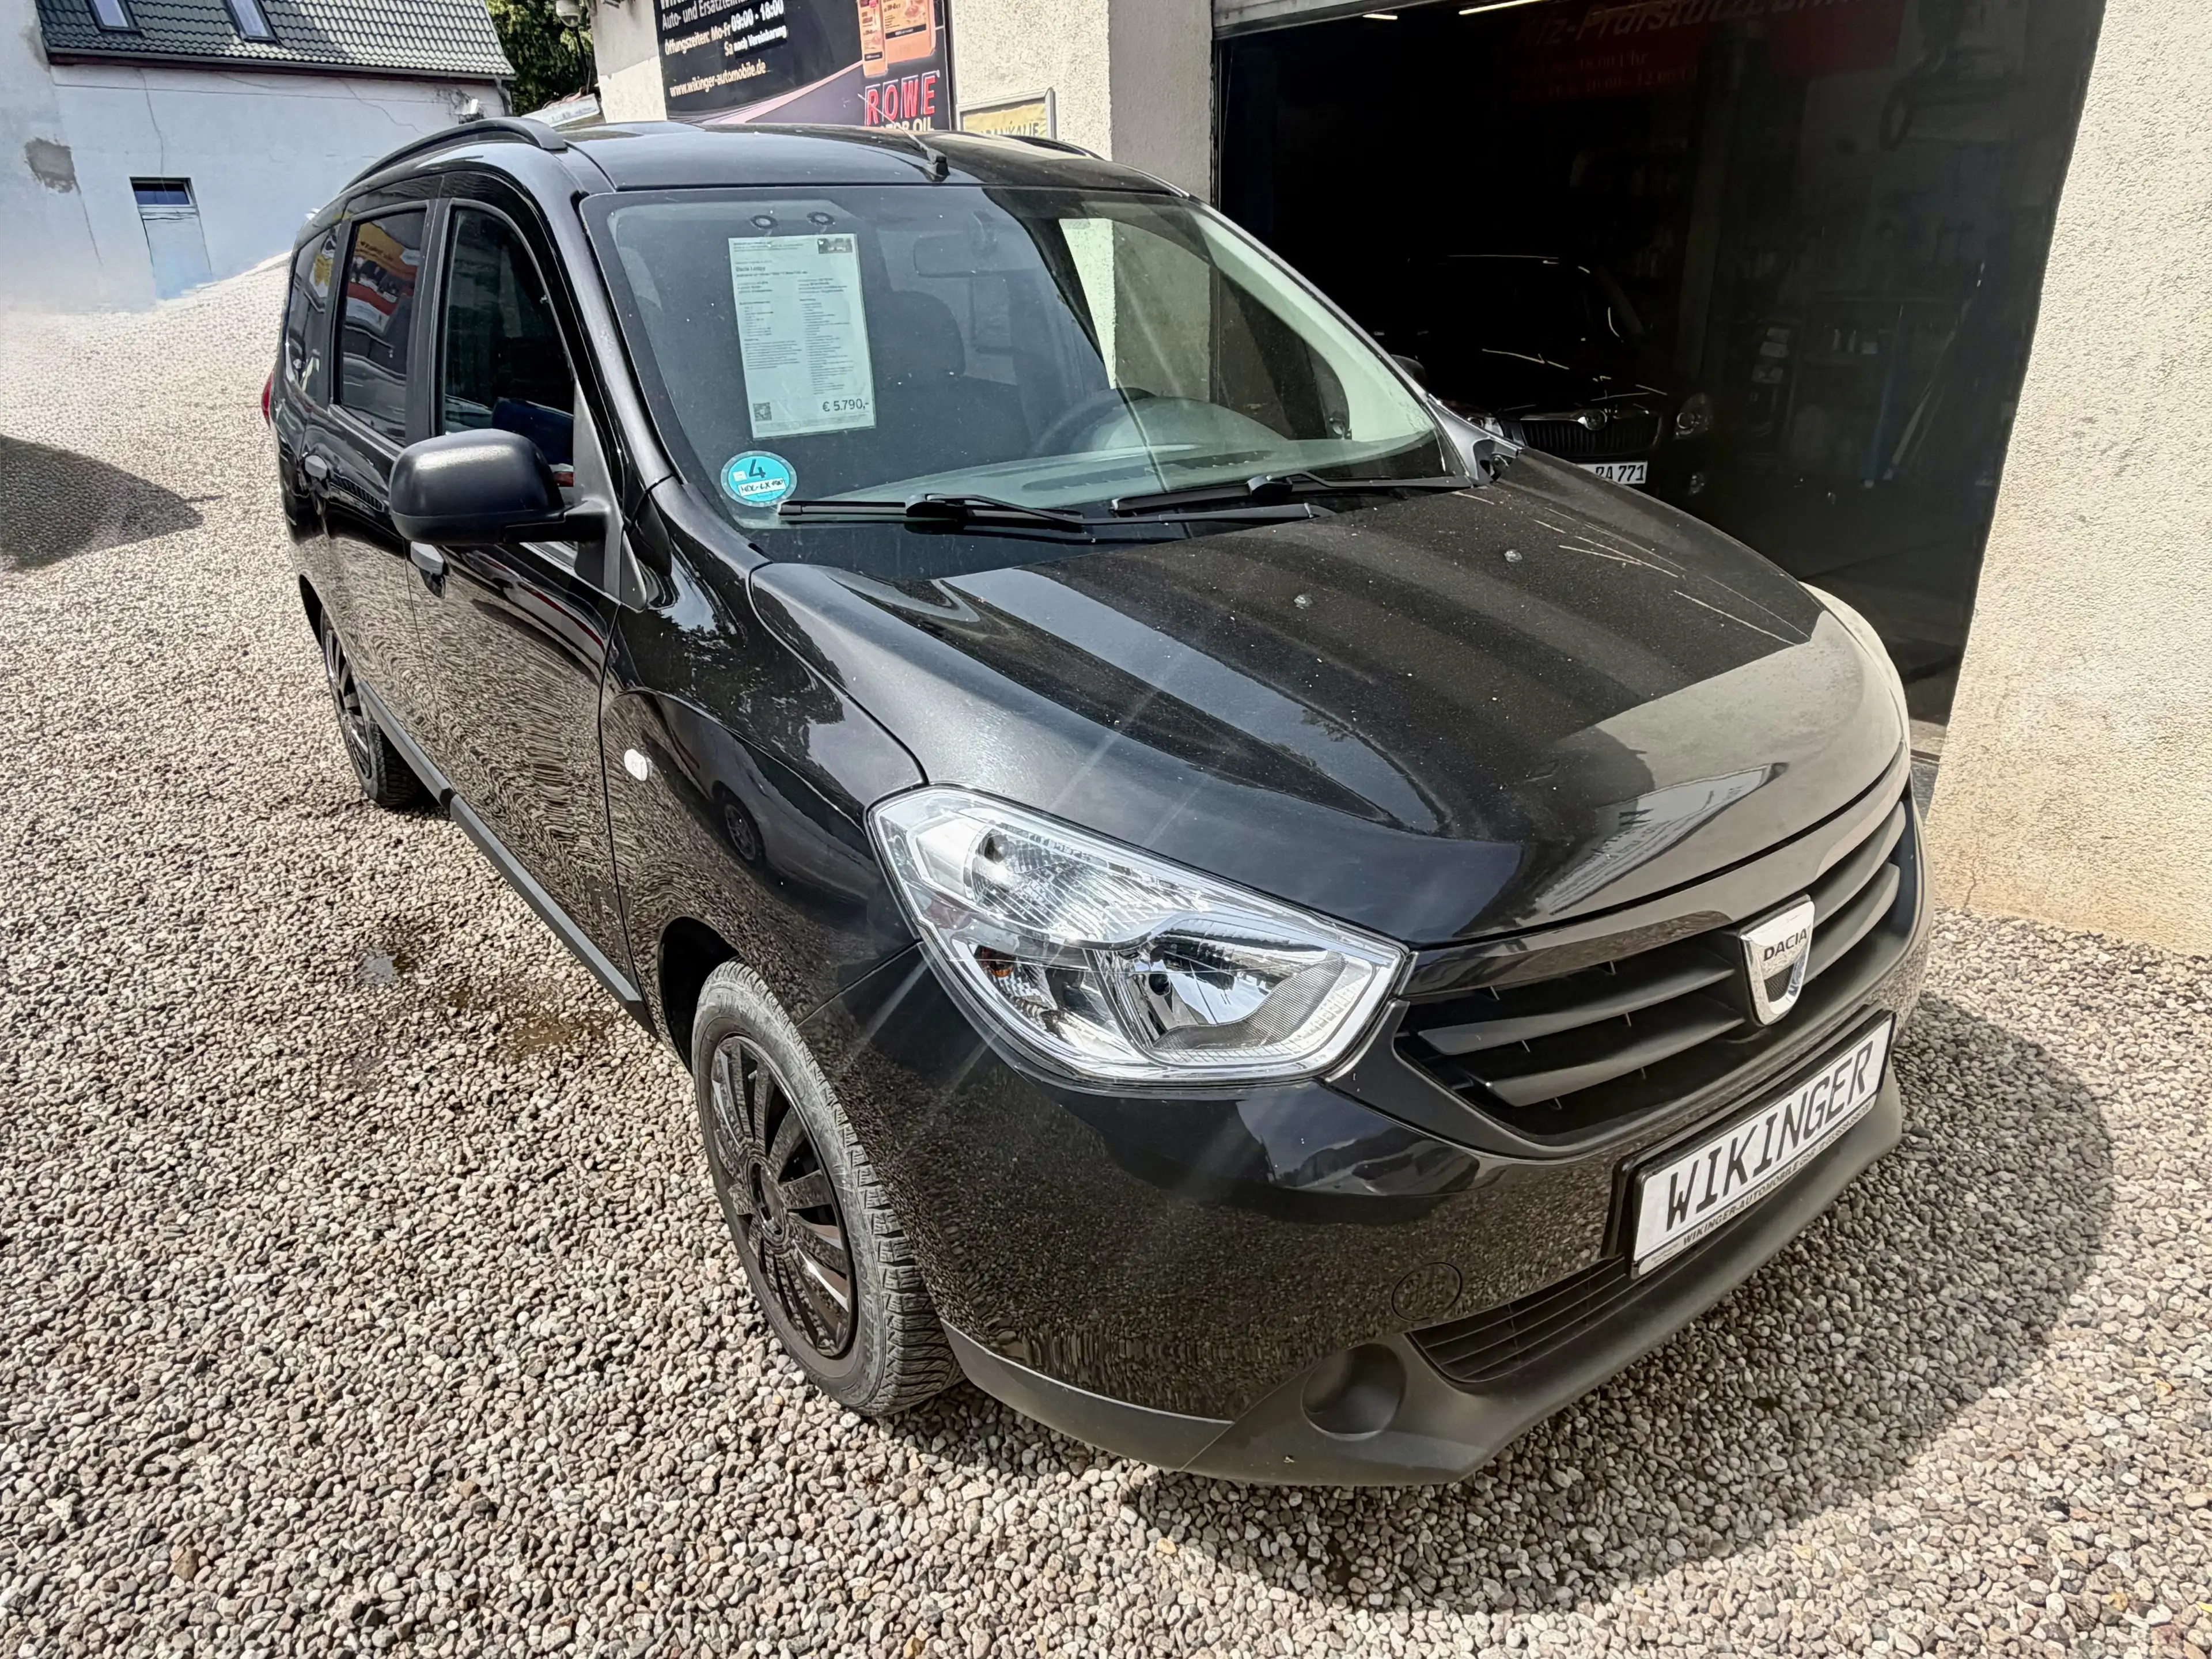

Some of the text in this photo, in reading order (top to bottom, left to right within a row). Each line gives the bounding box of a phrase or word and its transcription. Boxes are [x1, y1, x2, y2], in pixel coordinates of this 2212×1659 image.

[662, 12, 681, 31] Auto-
[682, 0, 698, 23] und
[730, 8, 754, 32] 09:00
[760, 0, 784, 21] 18:00
[724, 41, 733, 56] Sa
[866, 75, 936, 126] ROWE
[912, 116, 935, 132] OIL
[822, 398, 869, 412] € 5.790,-
[749, 459, 766, 478] 4
[1618, 464, 1645, 482] 771
[1763, 928, 1807, 962] DACIA
[1666, 1040, 1873, 1232] WIKINGER
[1683, 1159, 1799, 1246] WIKINGER-AUTOMOBILE
